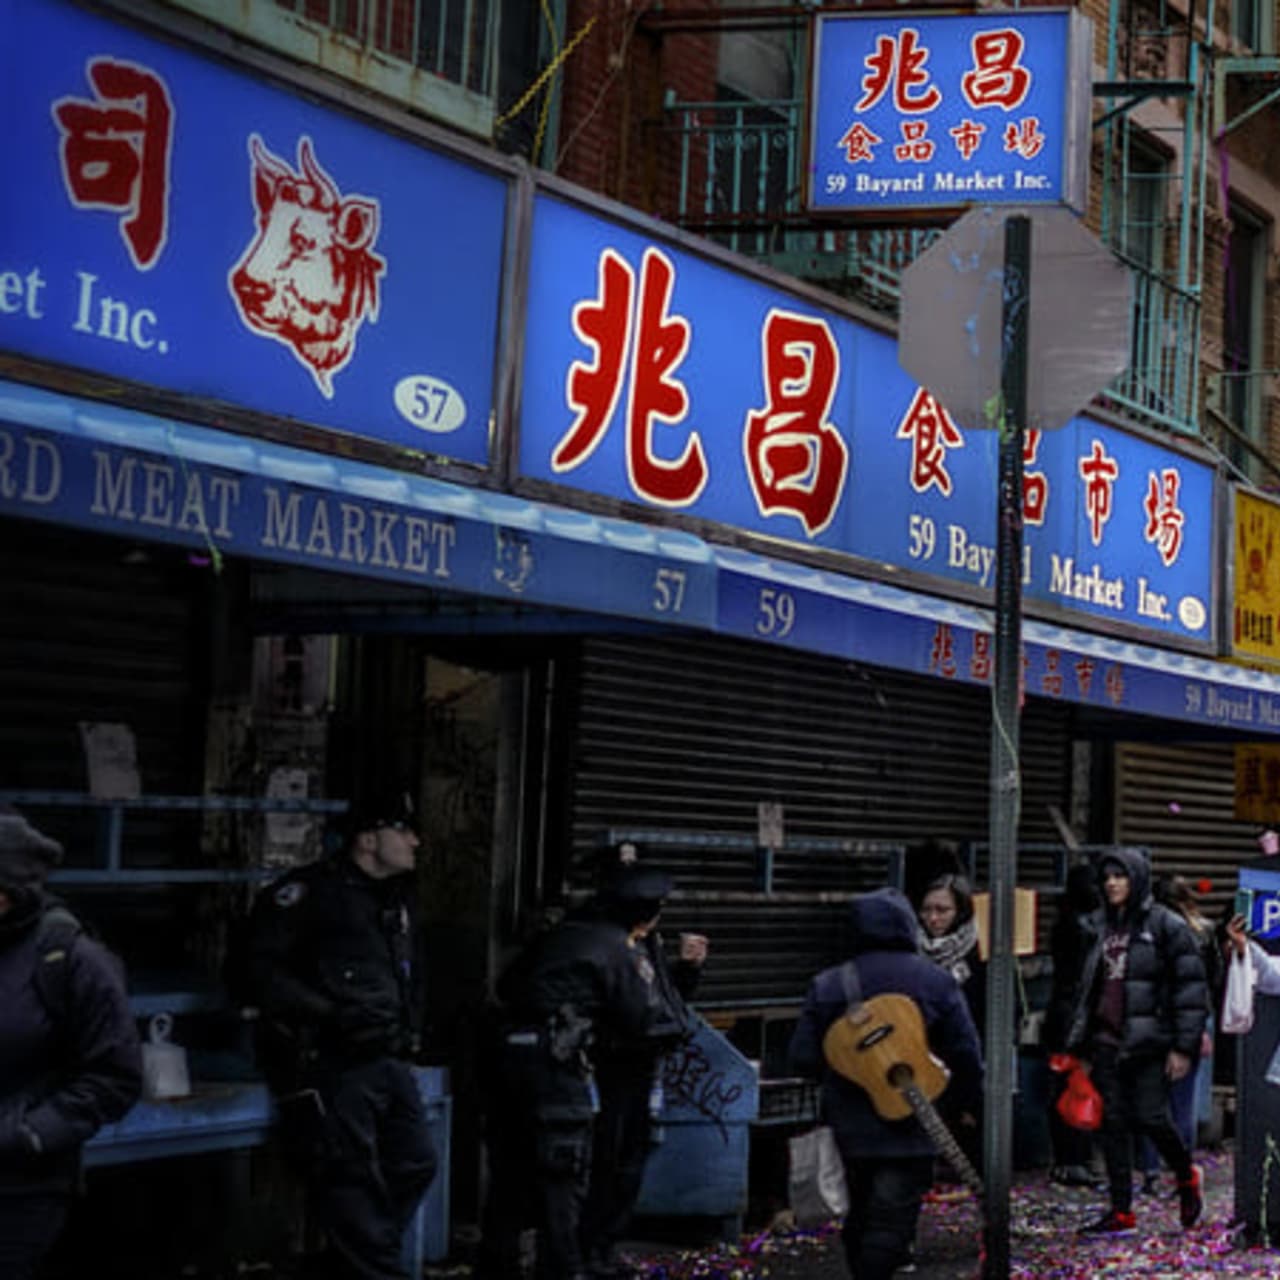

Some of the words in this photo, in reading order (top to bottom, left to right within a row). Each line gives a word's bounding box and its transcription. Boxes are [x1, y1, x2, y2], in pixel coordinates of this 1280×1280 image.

[854, 28, 1031, 113] 兆昌
[52, 56, 176, 271] 司
[837, 117, 1046, 162] 食品市場
[826, 175, 846, 193] 59
[856, 172, 925, 197] Bayard
[933, 171, 1003, 192] Market
[1014, 169, 1052, 190] Inc.
[0, 267, 46, 319] et
[72, 271, 169, 354] Inc.
[410, 382, 450, 425] 57
[90, 450, 241, 540] MEAT
[261, 487, 456, 578] MARKET
[653, 568, 686, 612] 57
[909, 514, 936, 560] 59
[947, 524, 1032, 588] Bayd
[1050, 555, 1125, 611] Market
[1137, 578, 1173, 622] Inc.
[758, 588, 795, 637] 59
[929, 621, 1125, 704] 兆昌品市場
